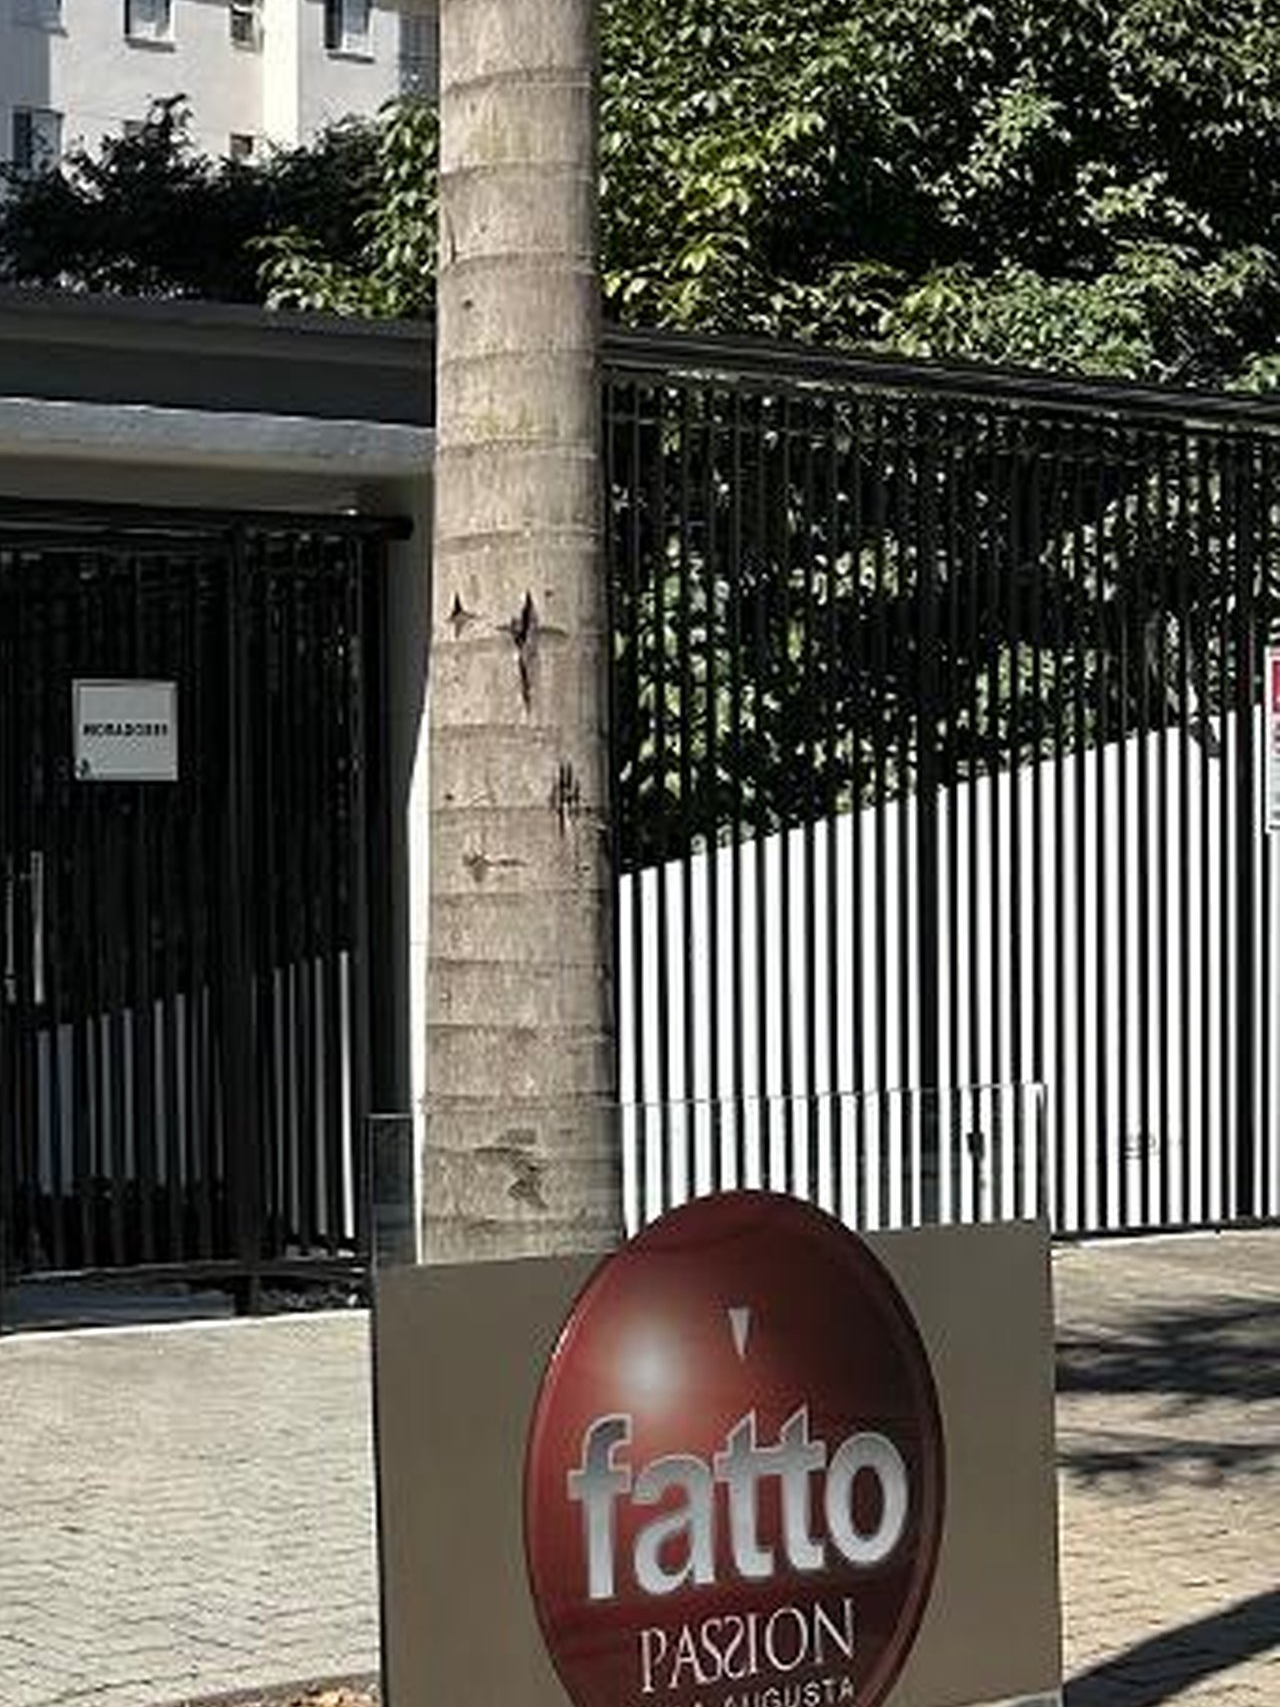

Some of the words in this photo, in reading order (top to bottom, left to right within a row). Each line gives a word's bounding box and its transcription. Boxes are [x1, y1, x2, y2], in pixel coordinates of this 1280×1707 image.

[82, 723, 168, 737] MORADORES
[566, 1404, 908, 1599] fatto
[641, 1596, 854, 1694] PASSION
